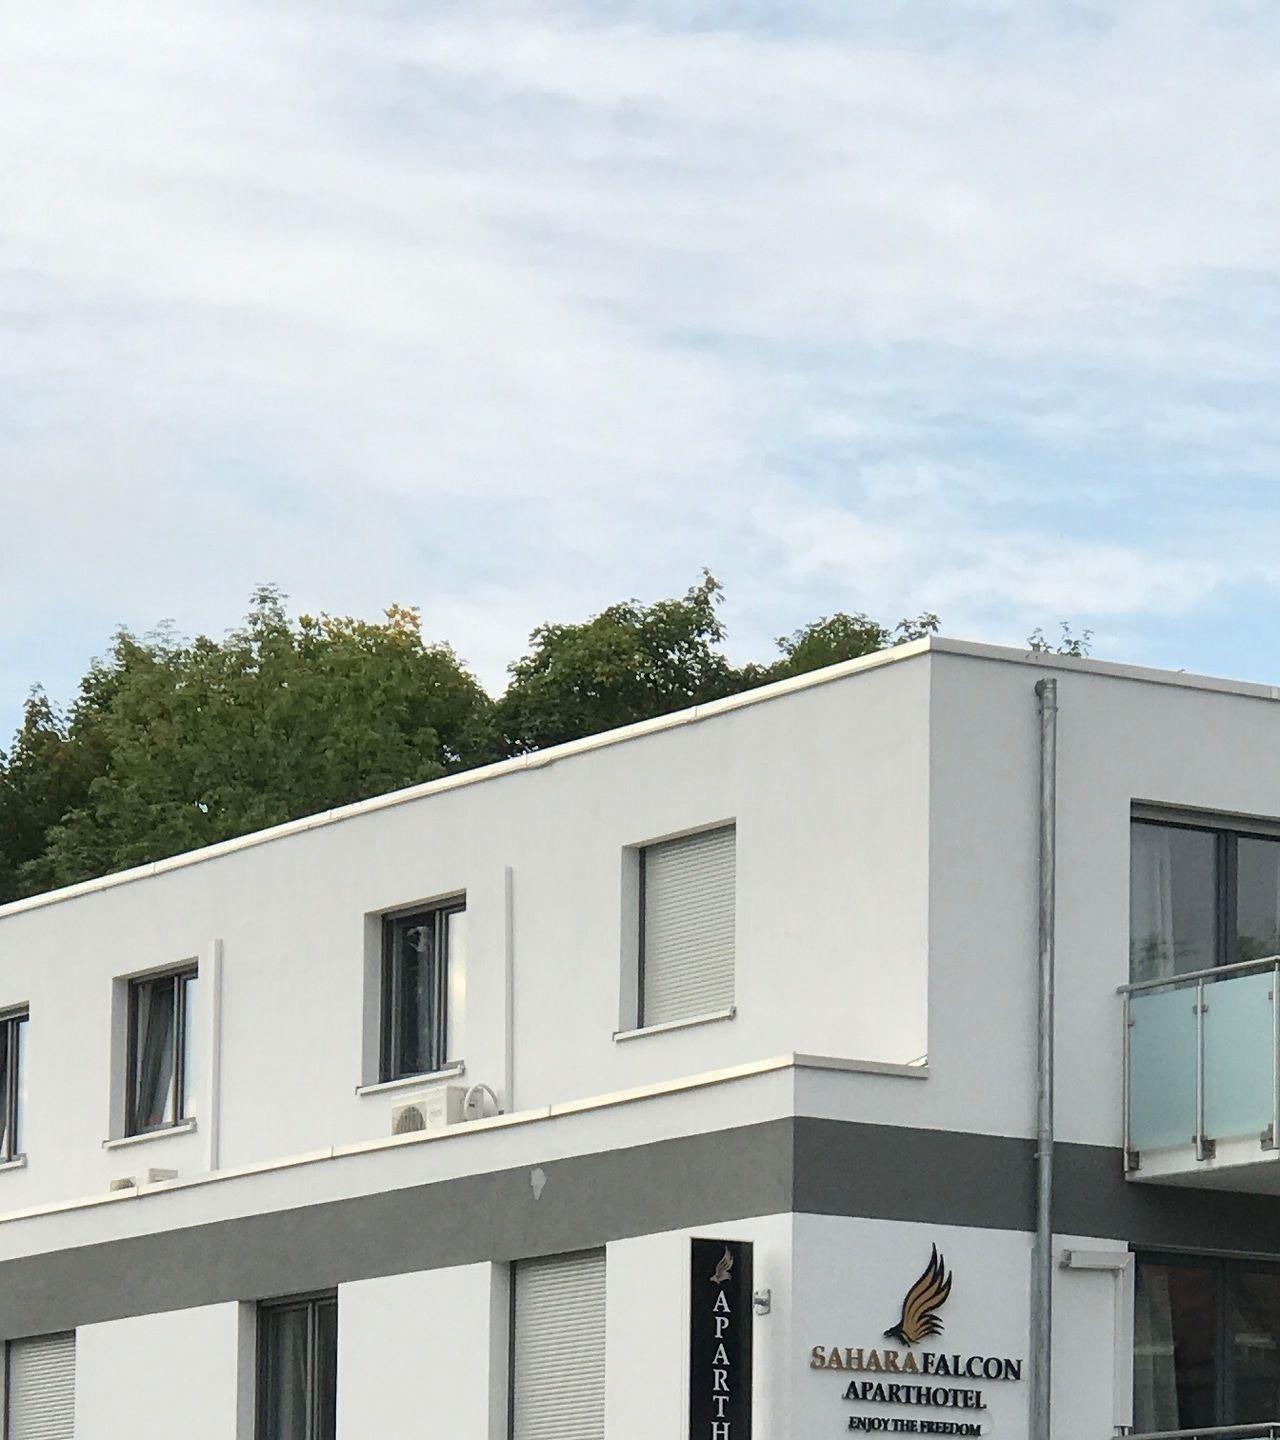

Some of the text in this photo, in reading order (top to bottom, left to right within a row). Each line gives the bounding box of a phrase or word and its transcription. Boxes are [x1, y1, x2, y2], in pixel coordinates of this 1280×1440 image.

[810, 1345, 1023, 1381] SAHARA FALCON
[842, 1380, 988, 1410] APARTHOTEL
[847, 1415, 982, 1438] ENJOY THE FREEDOM
